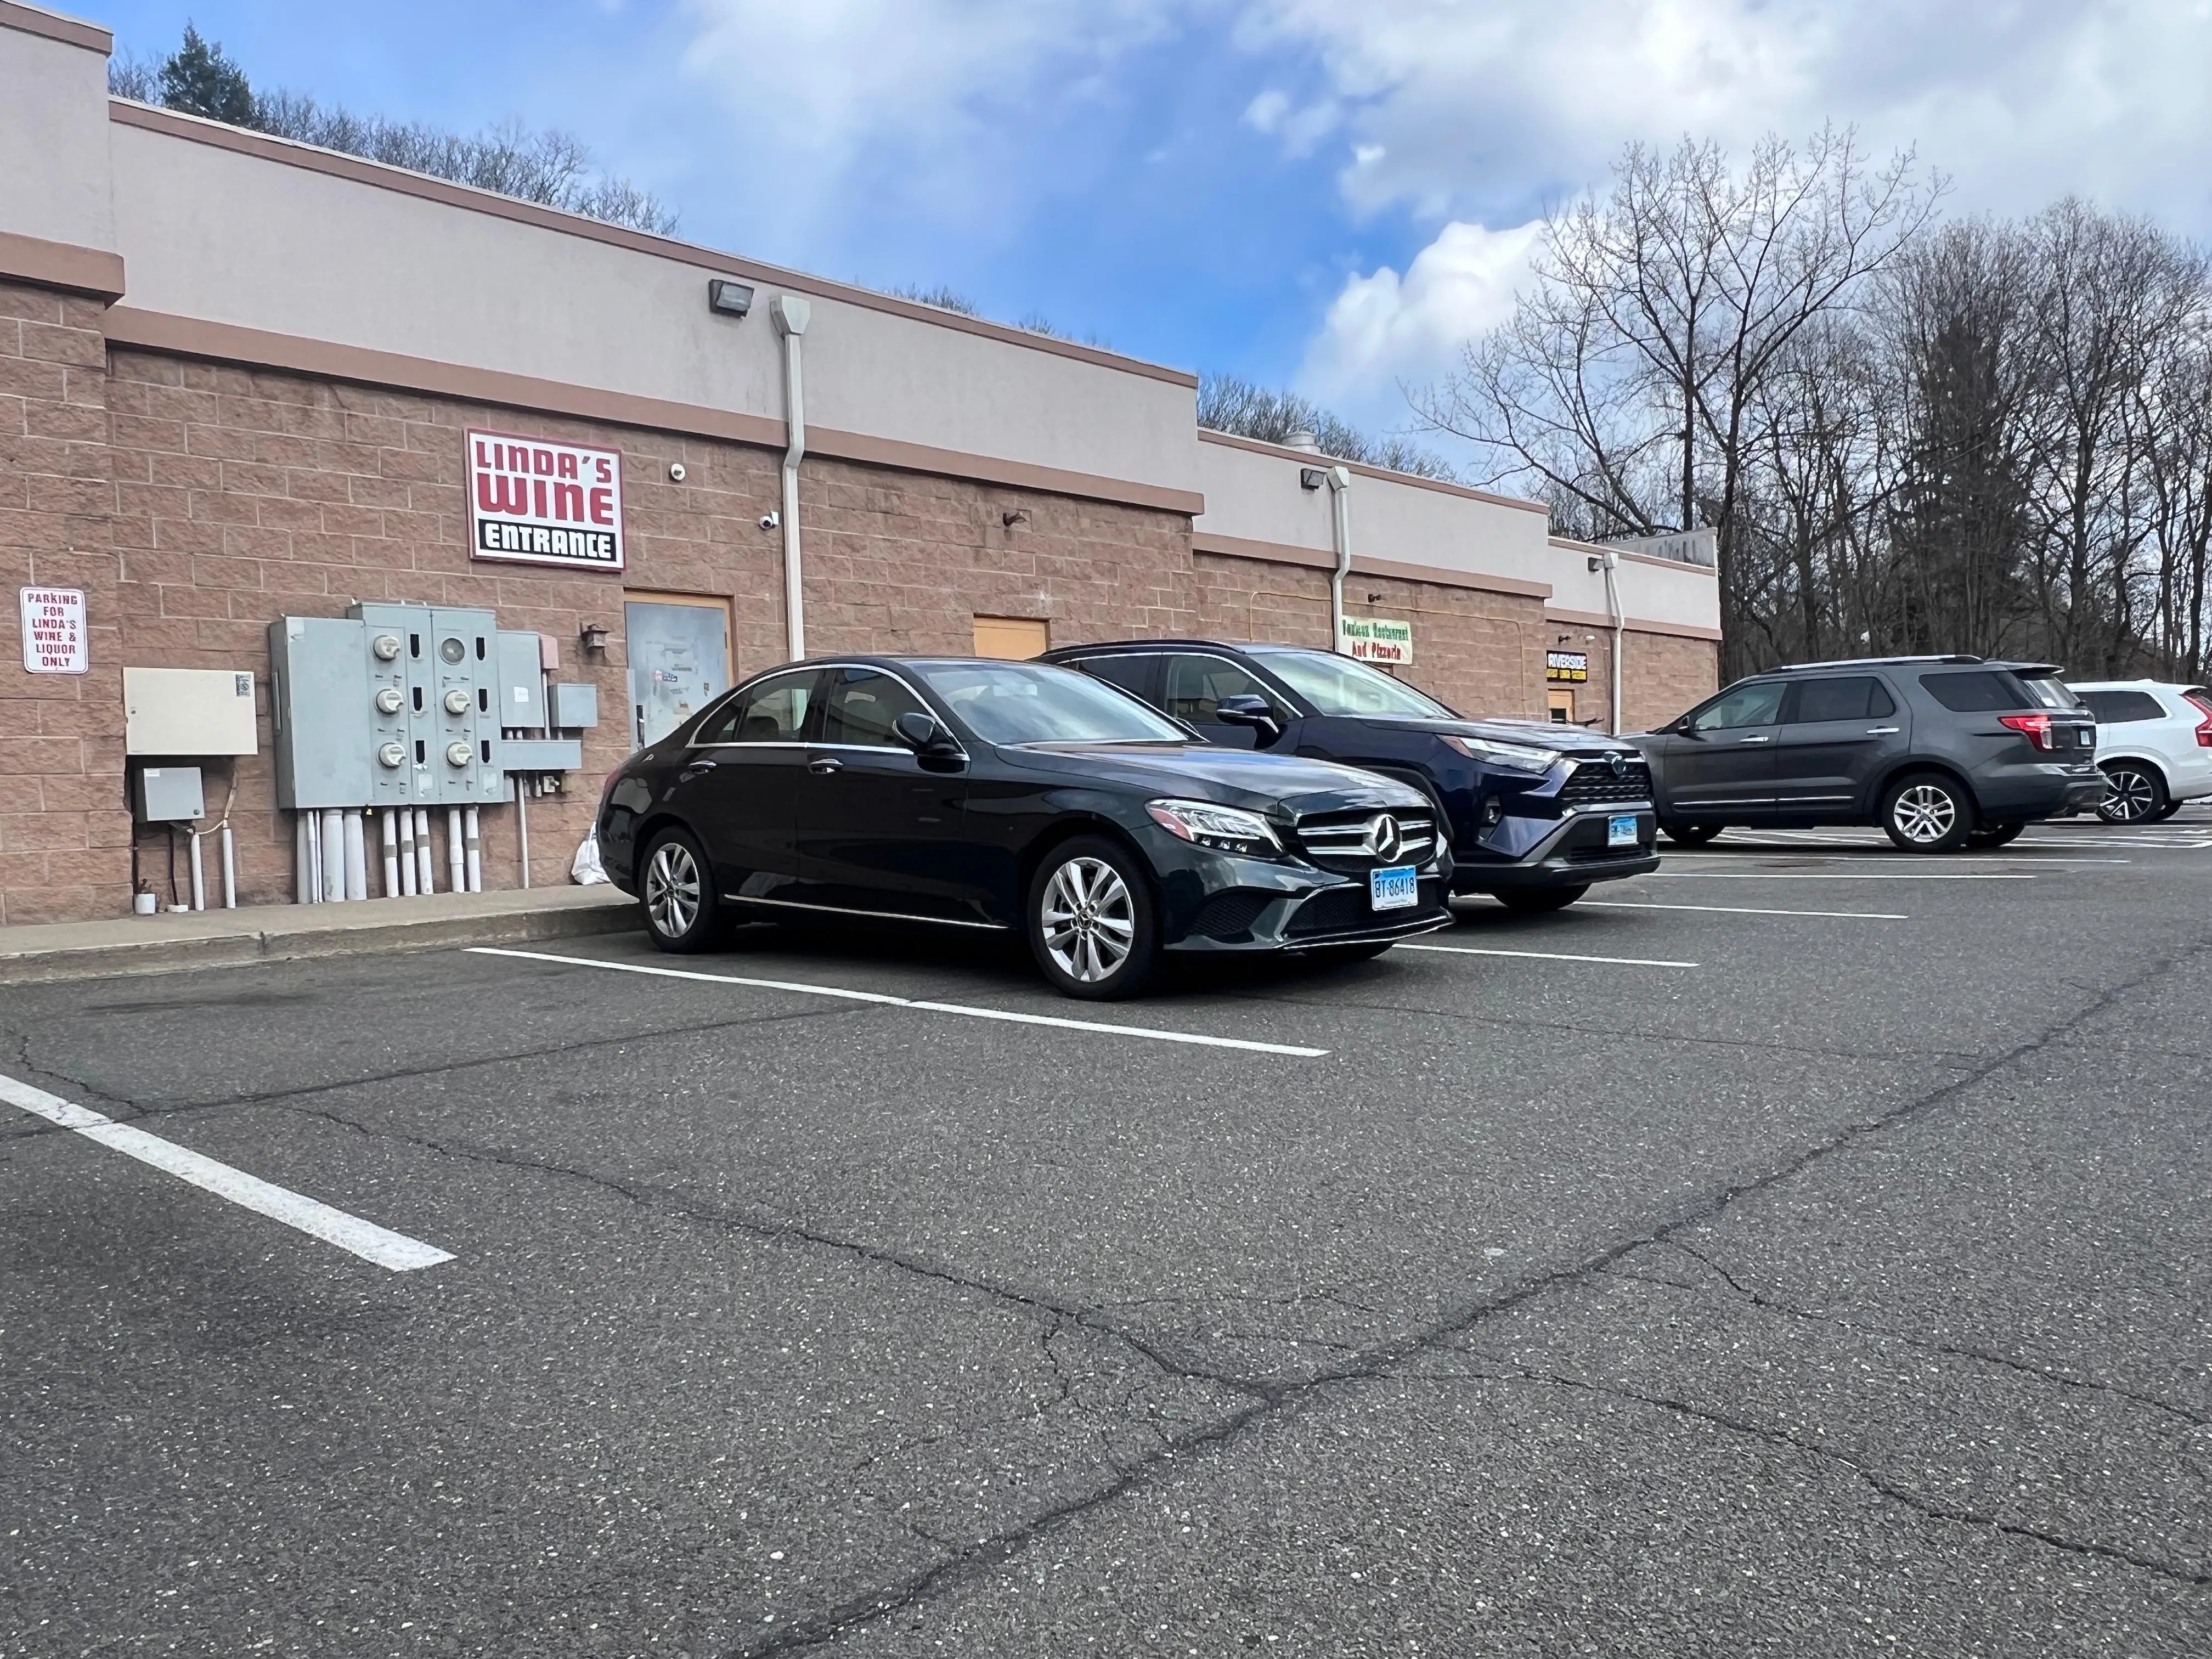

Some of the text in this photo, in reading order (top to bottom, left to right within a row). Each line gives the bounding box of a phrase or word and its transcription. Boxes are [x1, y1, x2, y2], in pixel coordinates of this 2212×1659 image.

[476, 441, 612, 483] LINDA'S
[477, 472, 614, 526] WINE
[485, 523, 611, 558] ENTRANCE
[28, 593, 78, 605] PARKING
[43, 606, 64, 617] FOR
[32, 618, 76, 629] LINDA'S
[33, 631, 76, 642] WINE &
[36, 644, 76, 654] LIQUOR
[1352, 641, 1367, 658] And
[42, 657, 70, 667] ONLY
